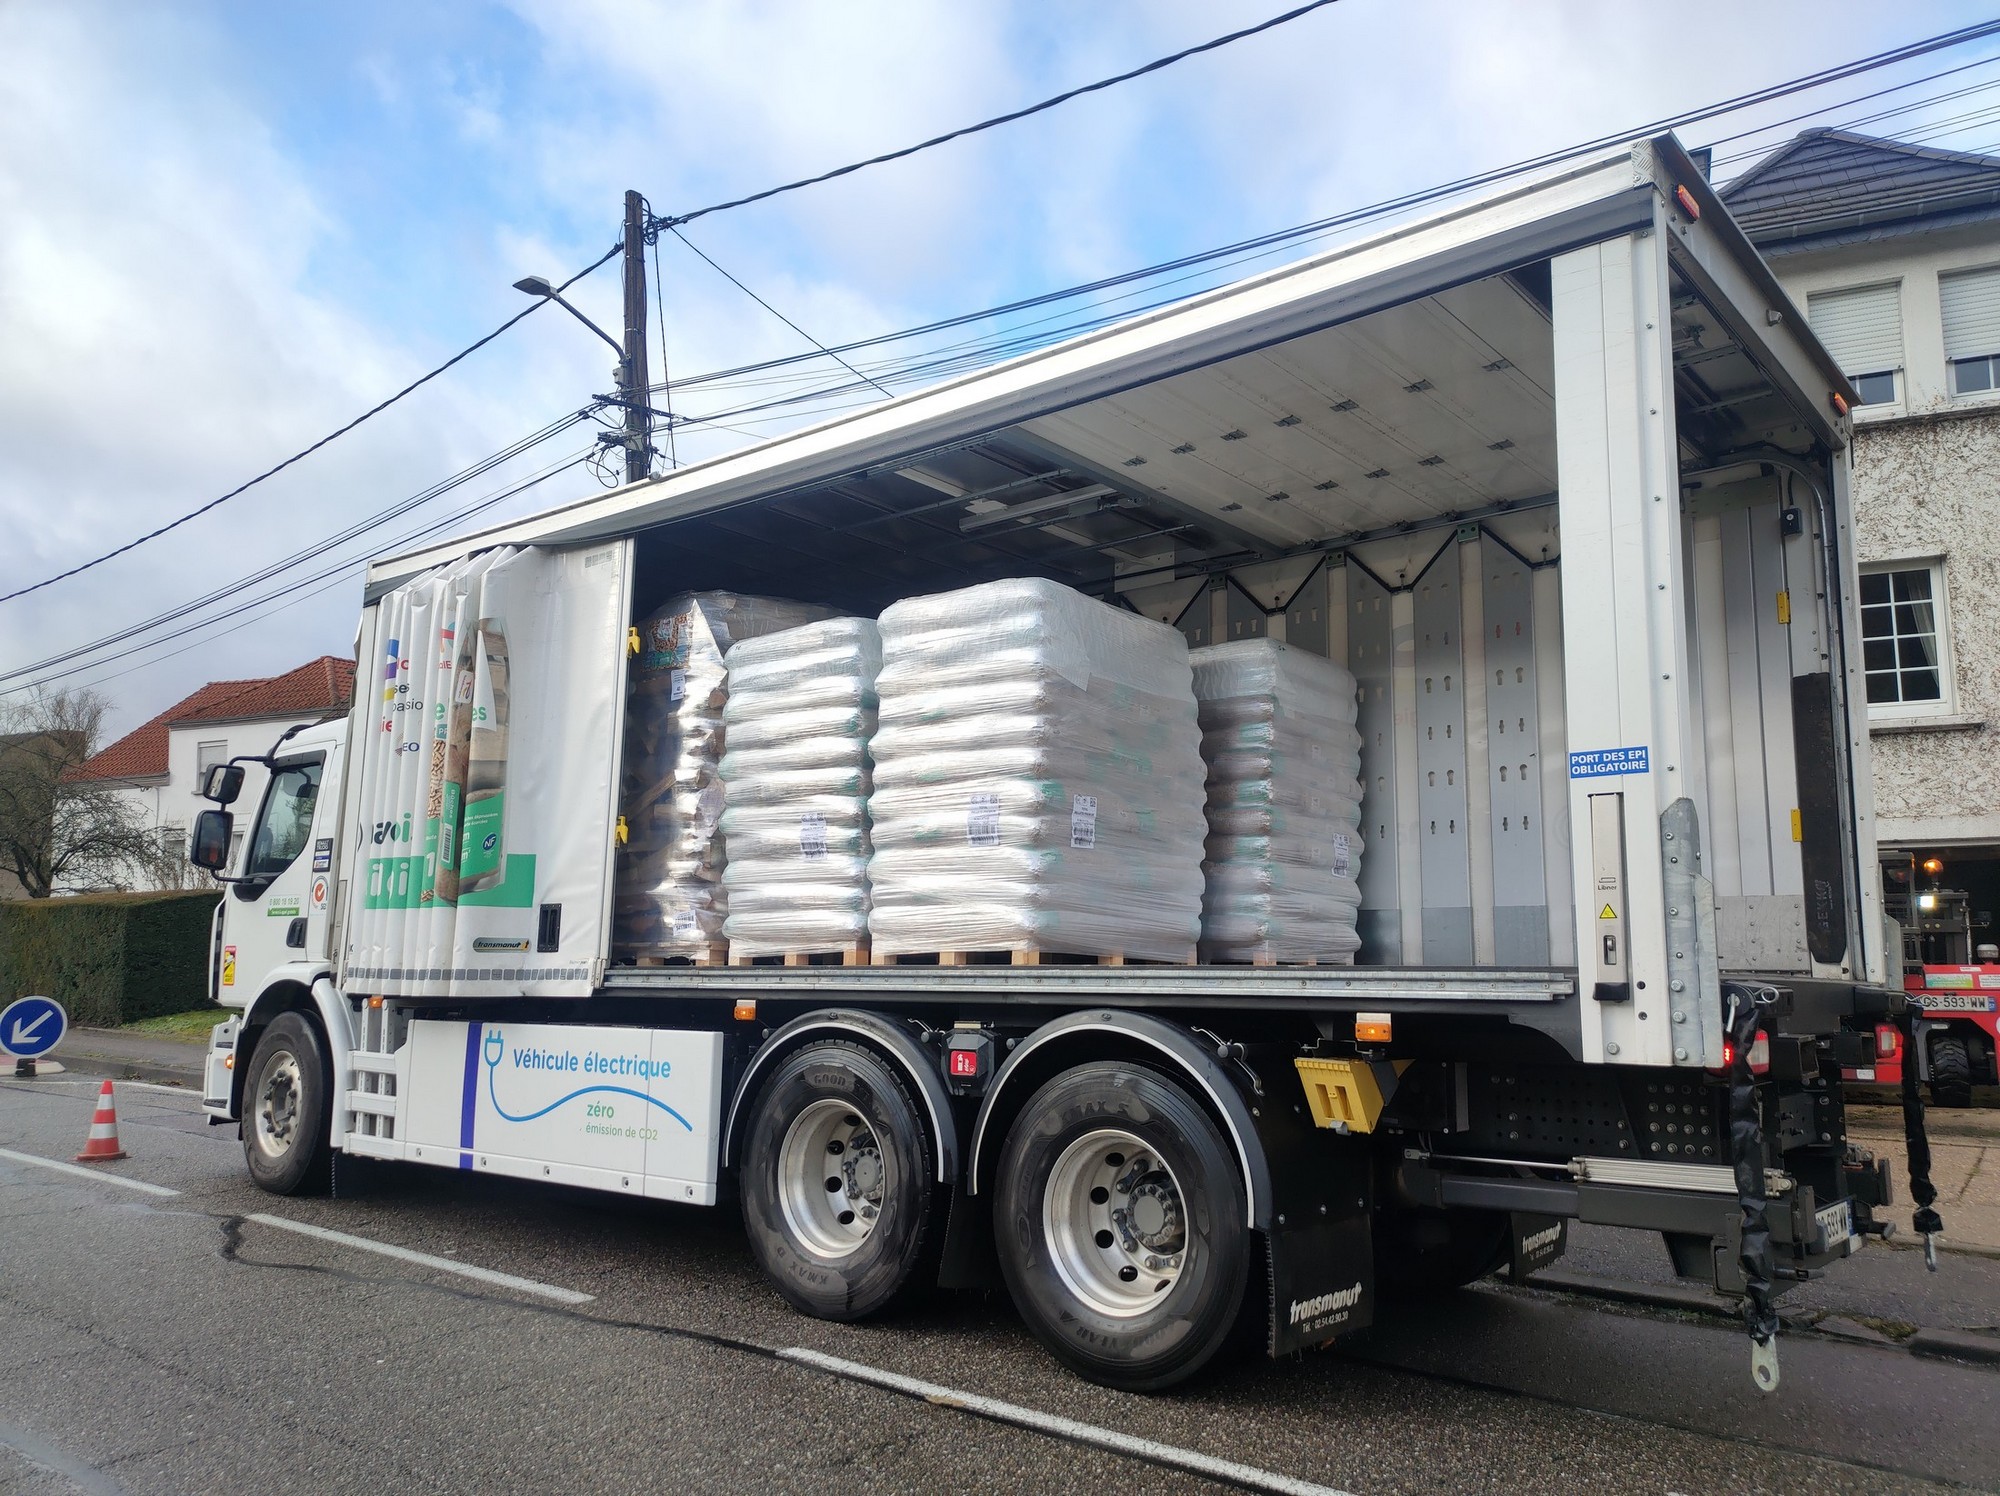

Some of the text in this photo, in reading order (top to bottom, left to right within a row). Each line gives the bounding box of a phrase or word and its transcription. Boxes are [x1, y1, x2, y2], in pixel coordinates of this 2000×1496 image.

[1571, 749, 1646, 765] PORT DES EPI
[1571, 760, 1646, 775] OBLIGATOIRE
[484, 836, 497, 848] NF
[513, 1047, 672, 1081] Véhicule électrique
[586, 1101, 615, 1119] zéro
[585, 1122, 658, 1141] émission de CO2
[1523, 1221, 1562, 1255] transmanut
[1289, 1281, 1362, 1325] transmanut
